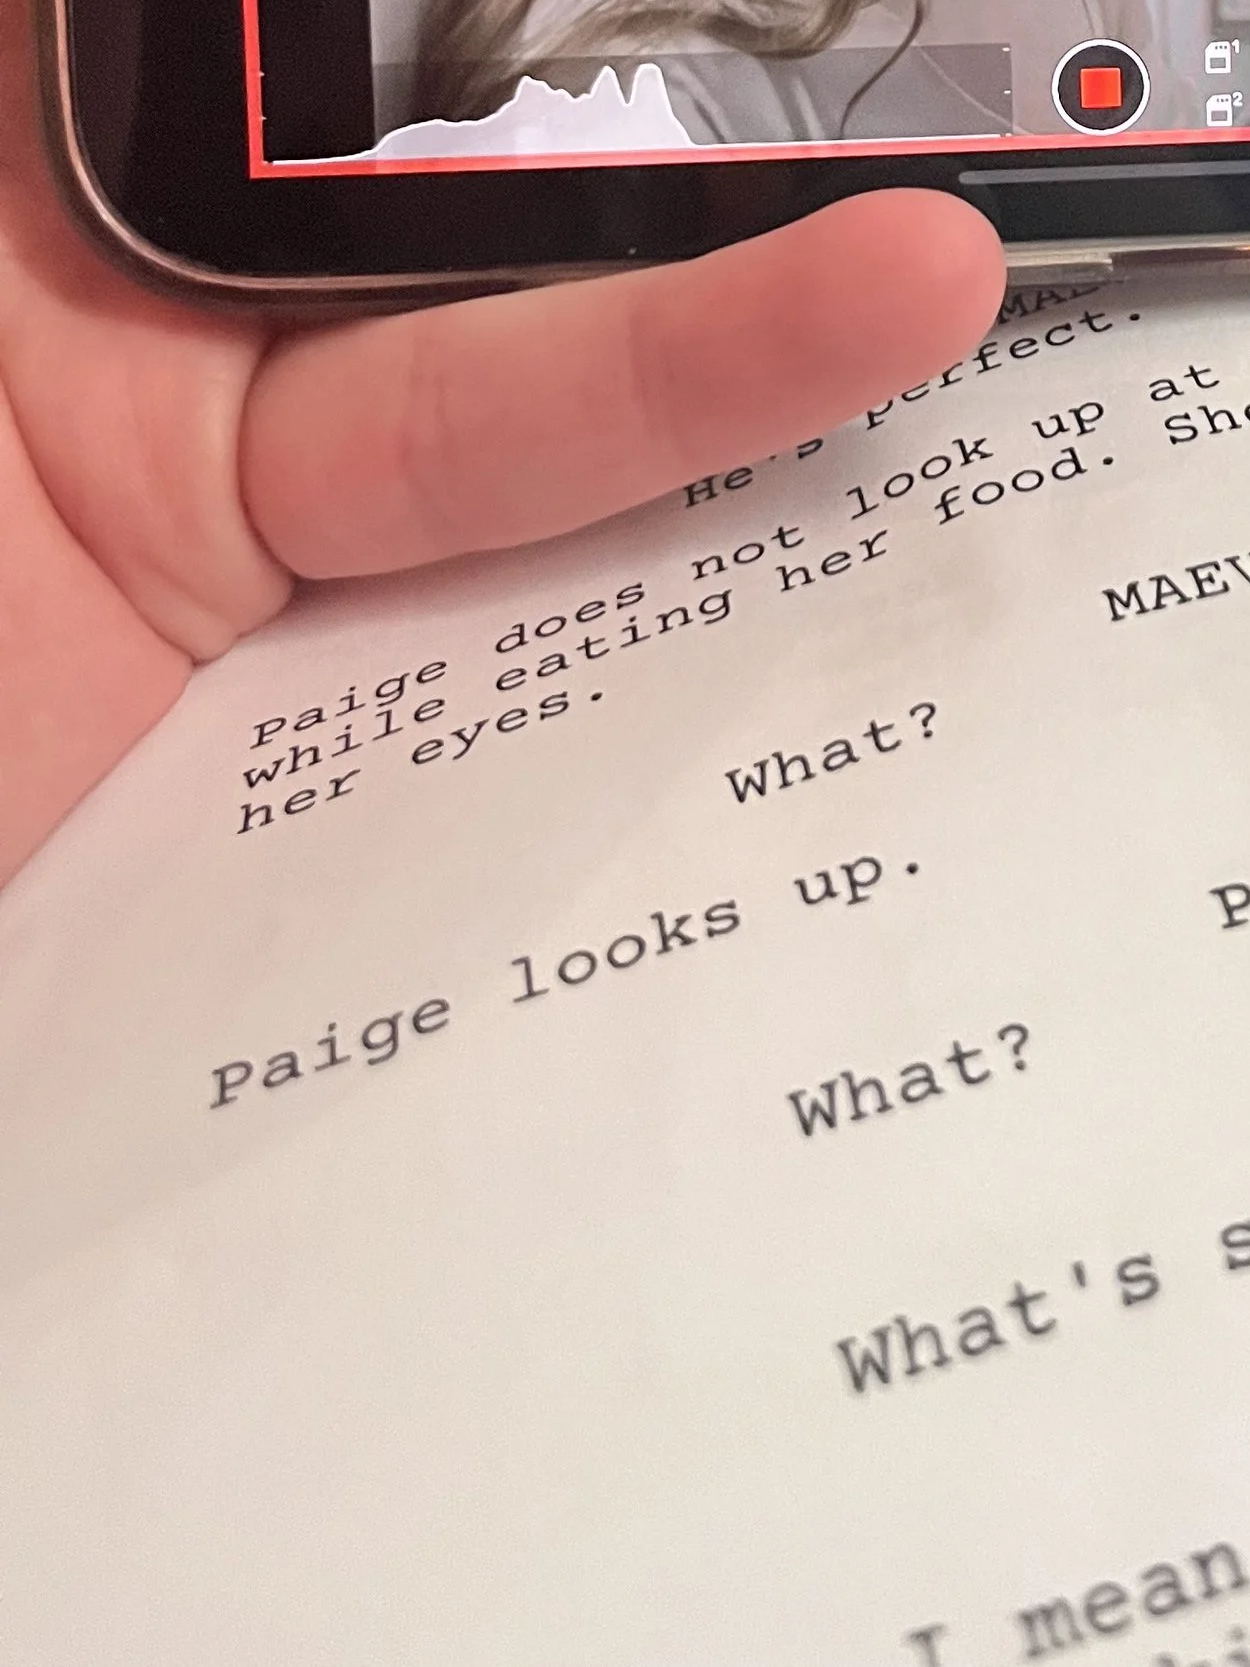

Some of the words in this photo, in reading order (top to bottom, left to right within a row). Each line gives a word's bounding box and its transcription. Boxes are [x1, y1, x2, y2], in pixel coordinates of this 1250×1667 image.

[682, 437, 824, 508] Hes
[242, 696, 447, 790] while
[494, 587, 733, 693] eating
[774, 529, 889, 593] her
[933, 445, 1115, 526] food.
[249, 656, 448, 750] Paige
[494, 581, 646, 654] does
[691, 524, 805, 582] not
[845, 437, 994, 520] look
[1031, 401, 1105, 441] up
[1148, 364, 1221, 402] at
[235, 768, 362, 835] her
[410, 686, 604, 766] eyes.
[724, 701, 938, 805] What?
[209, 997, 451, 1110] Paige
[511, 898, 741, 1004] looks
[793, 854, 920, 907] up.
[786, 1022, 1031, 1138] What?
[835, 1253, 1161, 1395] What's
